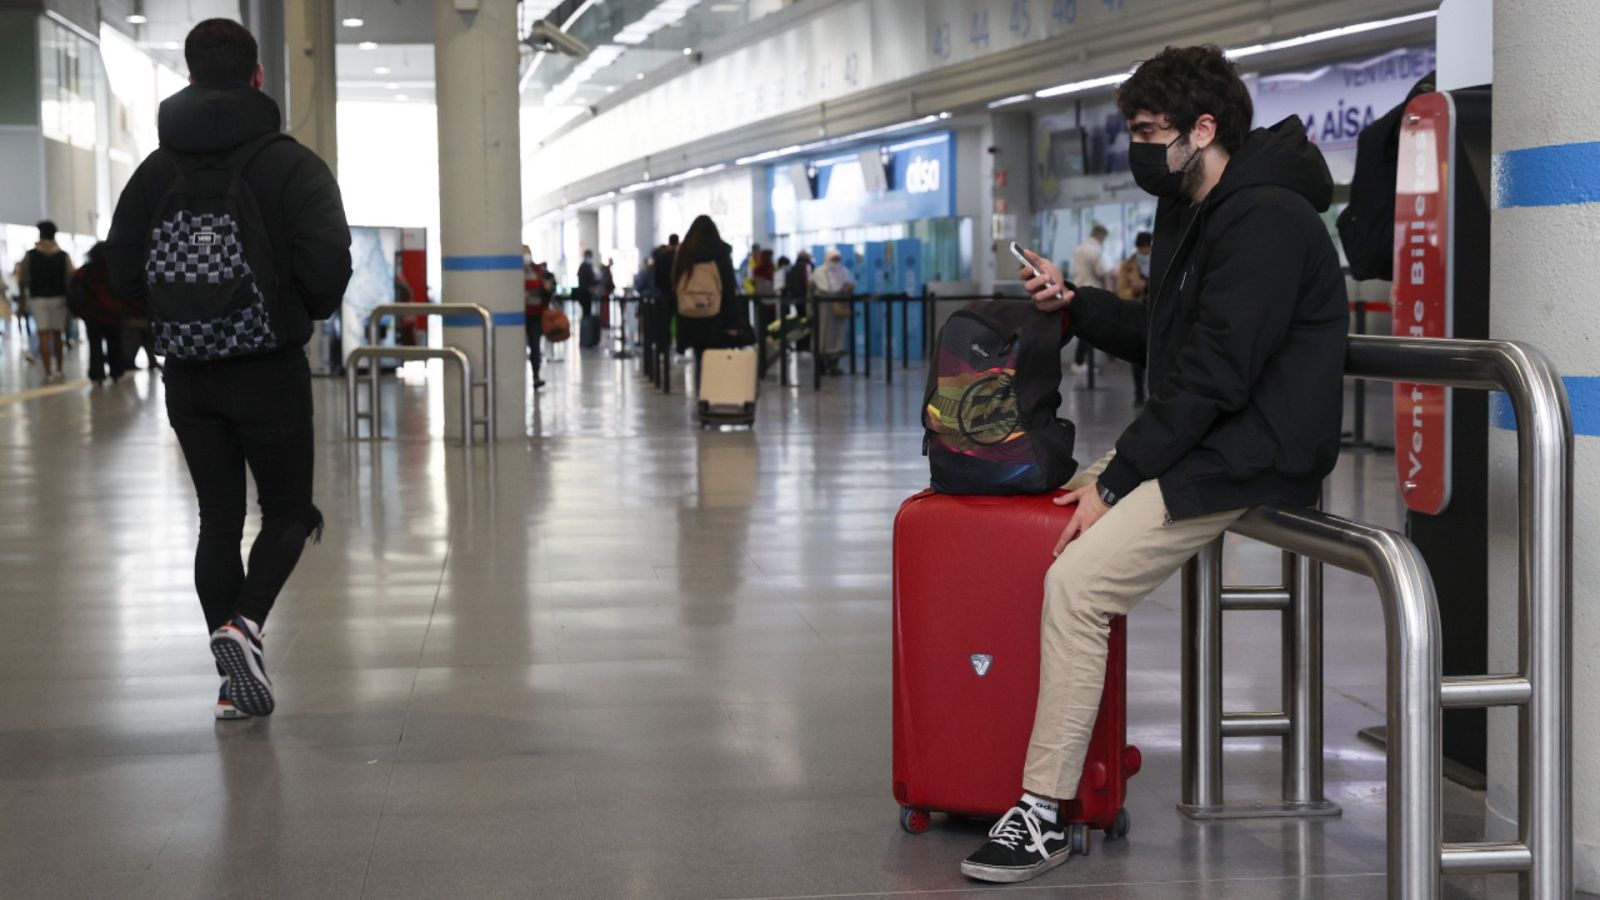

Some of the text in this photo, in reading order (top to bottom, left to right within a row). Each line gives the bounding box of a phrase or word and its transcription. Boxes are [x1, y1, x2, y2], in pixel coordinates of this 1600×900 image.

[969, 8, 990, 49] 44
[1411, 132, 1426, 285] Billetes
[1408, 384, 1423, 478] Vent
